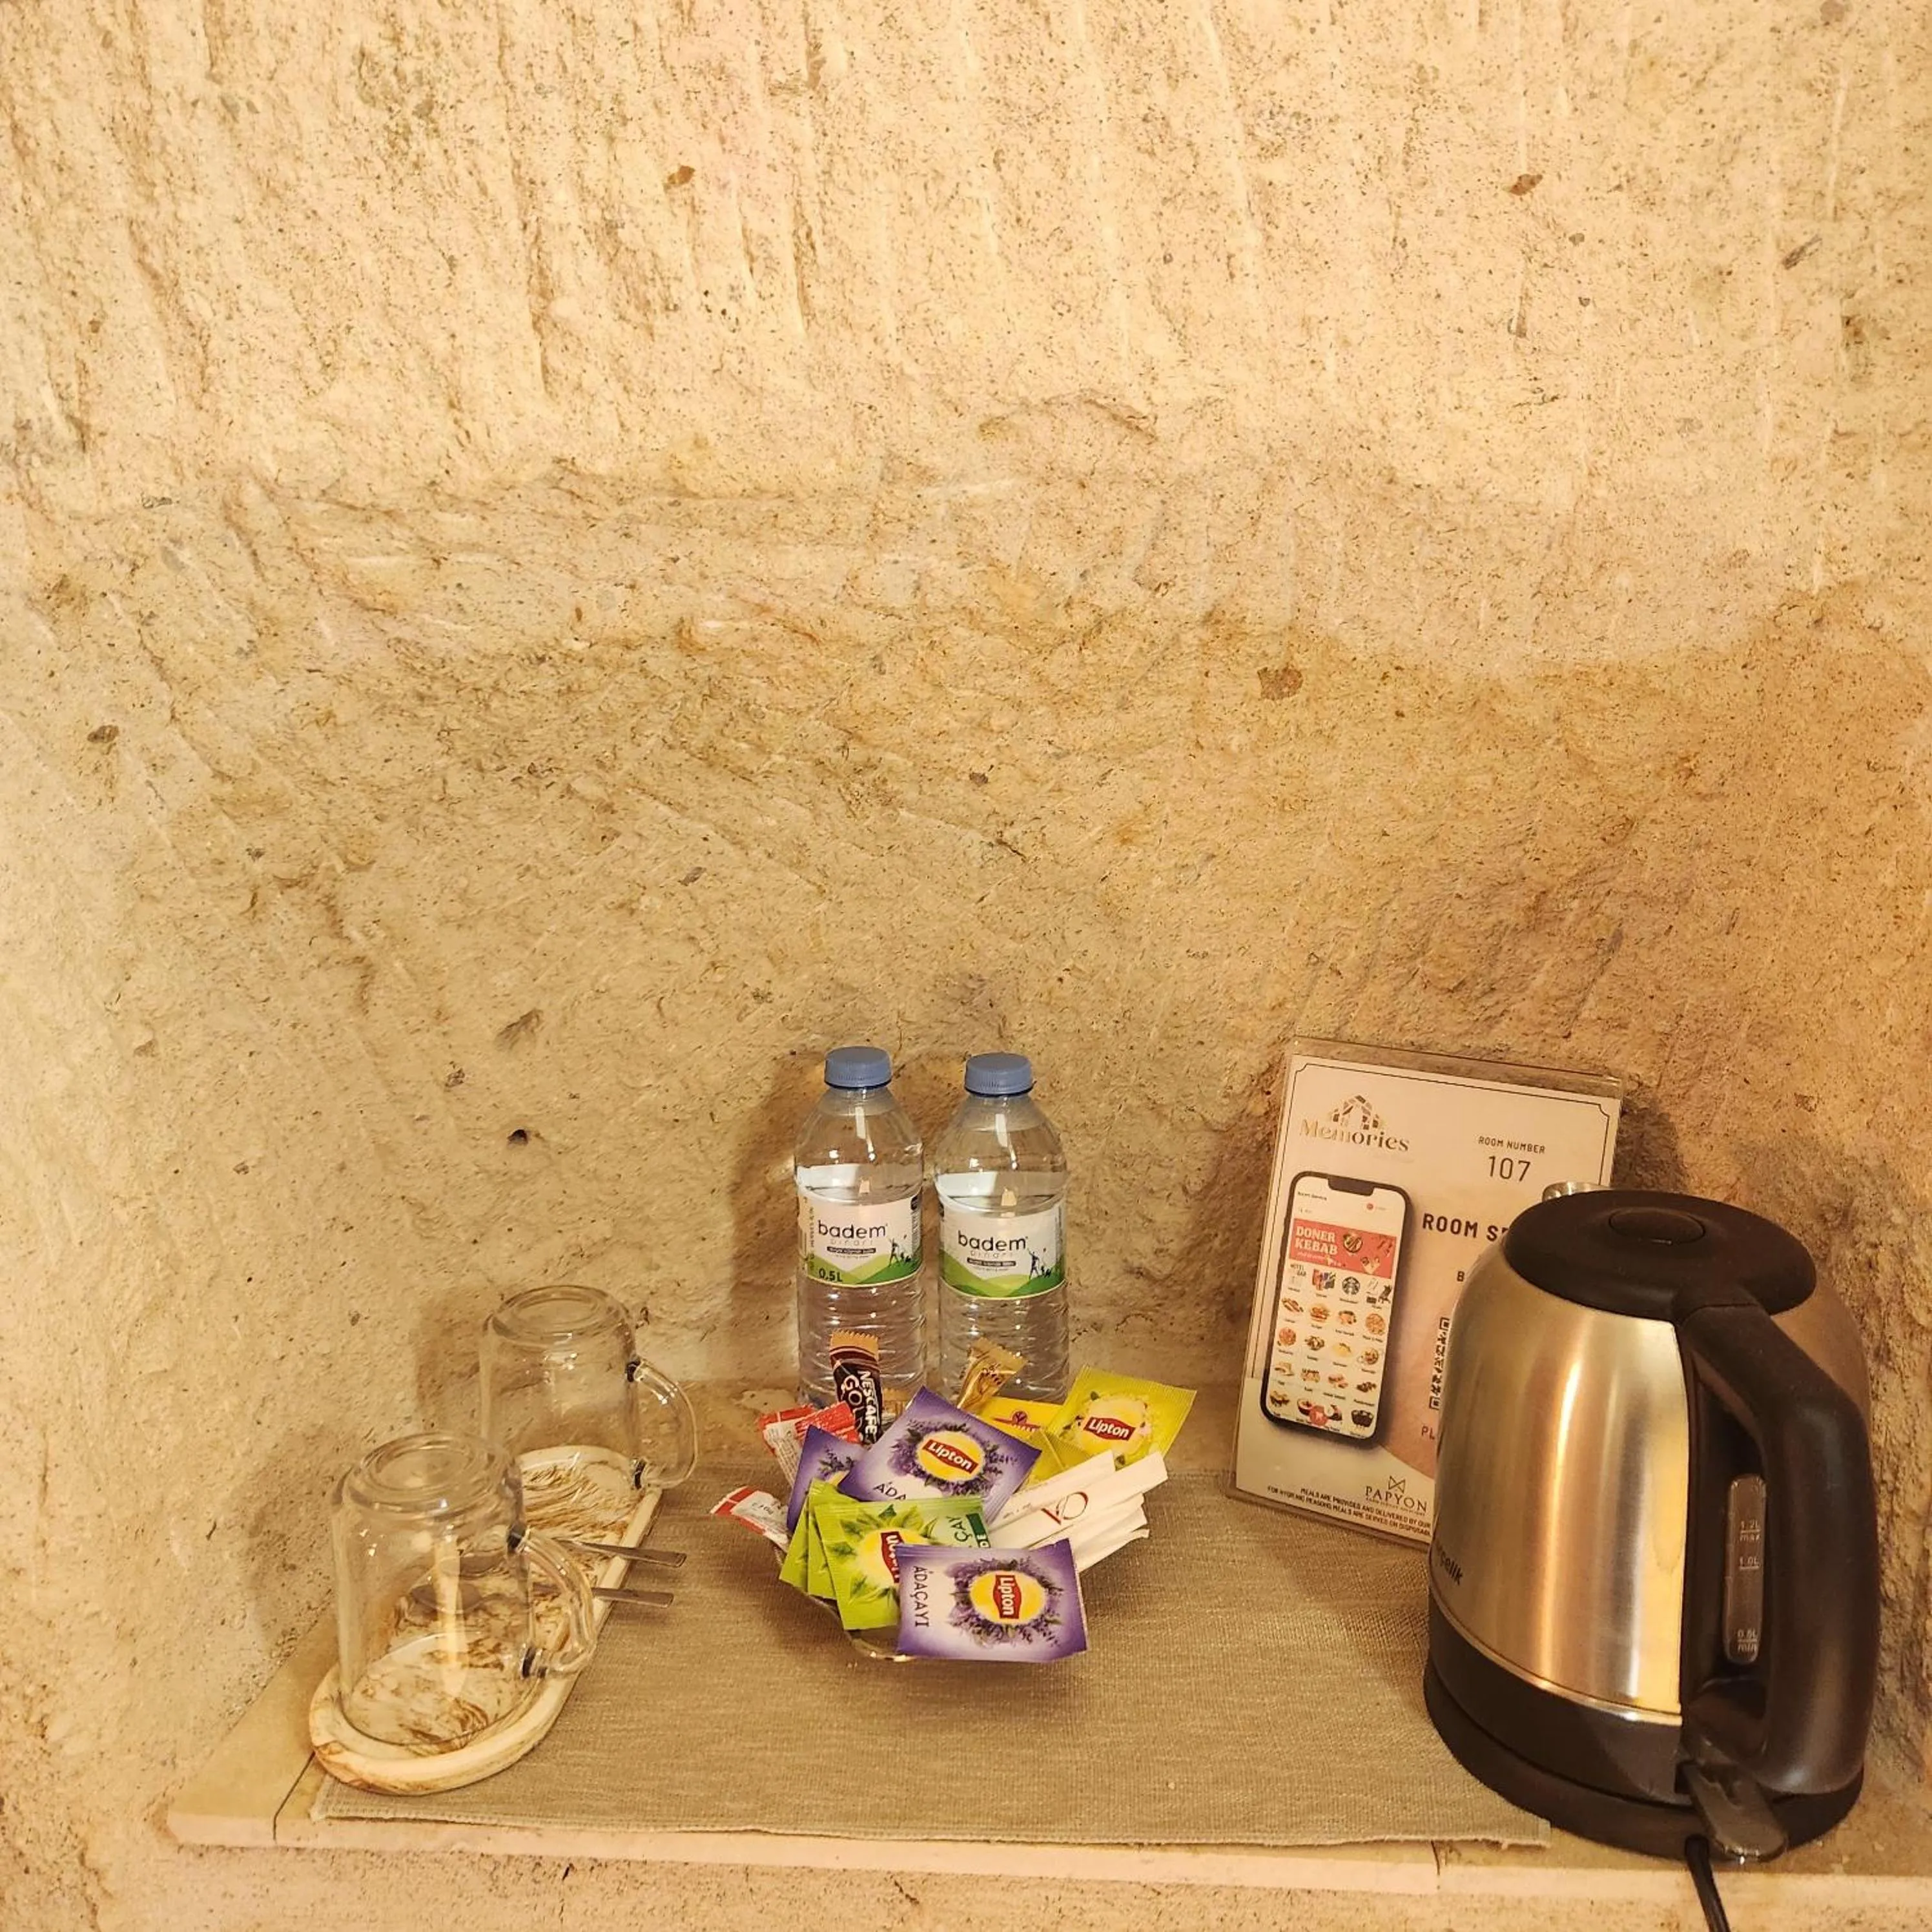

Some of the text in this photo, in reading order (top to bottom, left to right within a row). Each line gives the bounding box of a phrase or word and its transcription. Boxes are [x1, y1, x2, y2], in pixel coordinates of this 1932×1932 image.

[1299, 1118, 1410, 1152] Memories
[1478, 1136, 1546, 1154] ROOM NUMBER
[1488, 1155, 1532, 1182] 107
[817, 1219, 886, 1239] badem
[1295, 1225, 1335, 1243] DONER
[1422, 1212, 1479, 1239] ROOM
[958, 1229, 1027, 1252] badem
[1294, 1237, 1339, 1255] KEBAB
[1088, 1418, 1130, 1438] Lipton
[928, 1441, 972, 1470] Lipton
[1366, 1485, 1428, 1512] PAPYON
[910, 1565, 930, 1628] ADAÇAYI
[998, 1577, 1015, 1616] Lipton
